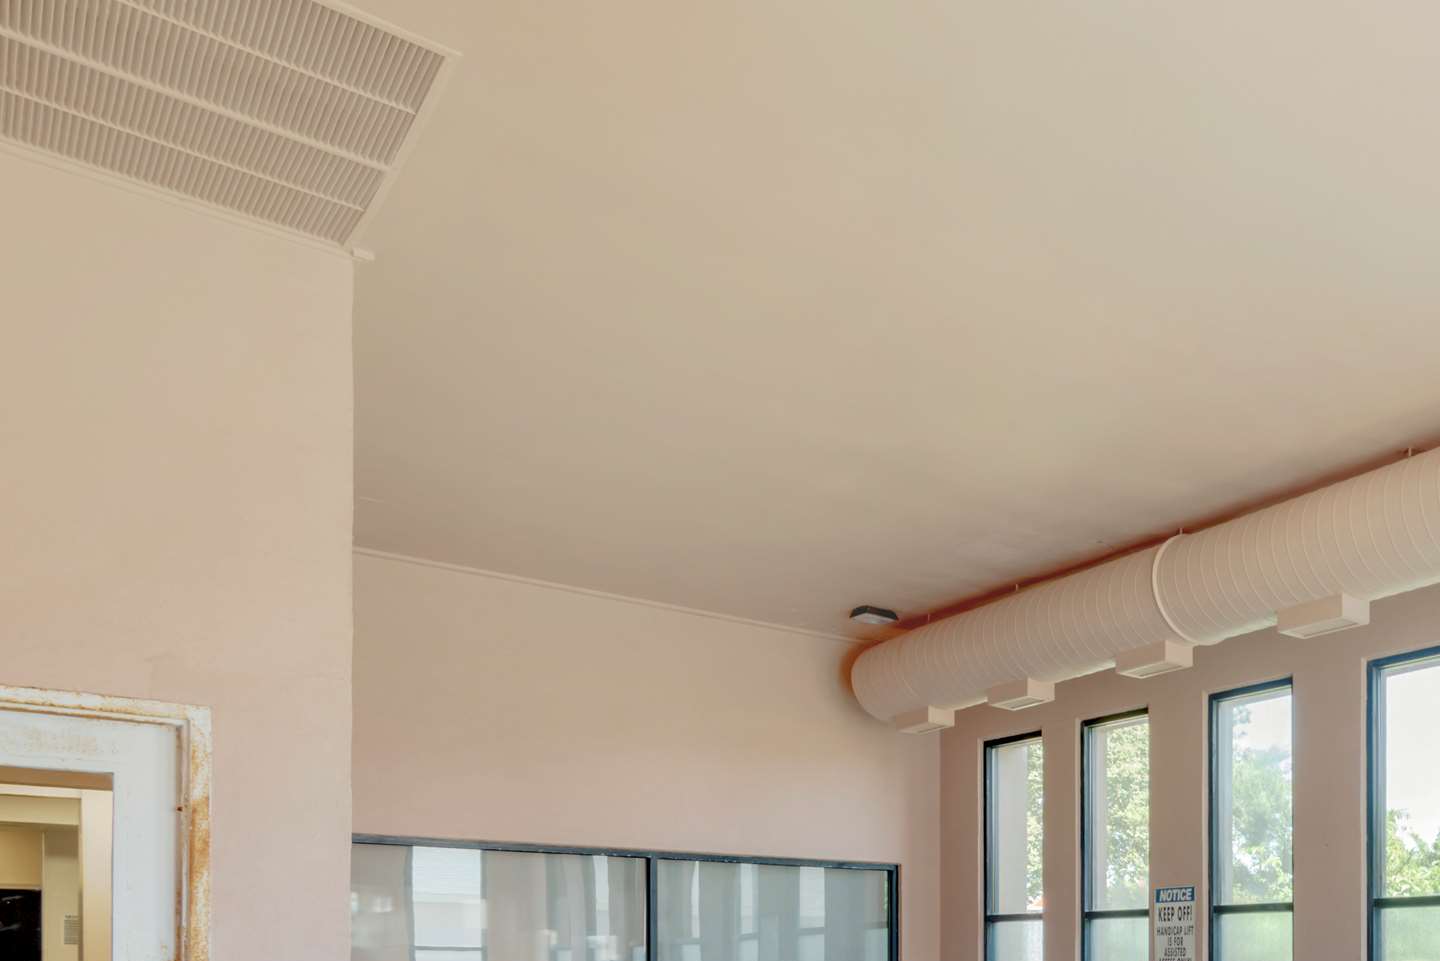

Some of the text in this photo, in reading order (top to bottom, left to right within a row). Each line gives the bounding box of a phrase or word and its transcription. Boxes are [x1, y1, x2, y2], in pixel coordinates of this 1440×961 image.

[1160, 888, 1193, 901] NOTICE
[1158, 905, 1175, 922] KEEP
[1157, 925, 1194, 936] HANDICAP LIFT
[1168, 937, 1184, 946] IS FOR
[1164, 947, 1187, 957] ASSISTED
